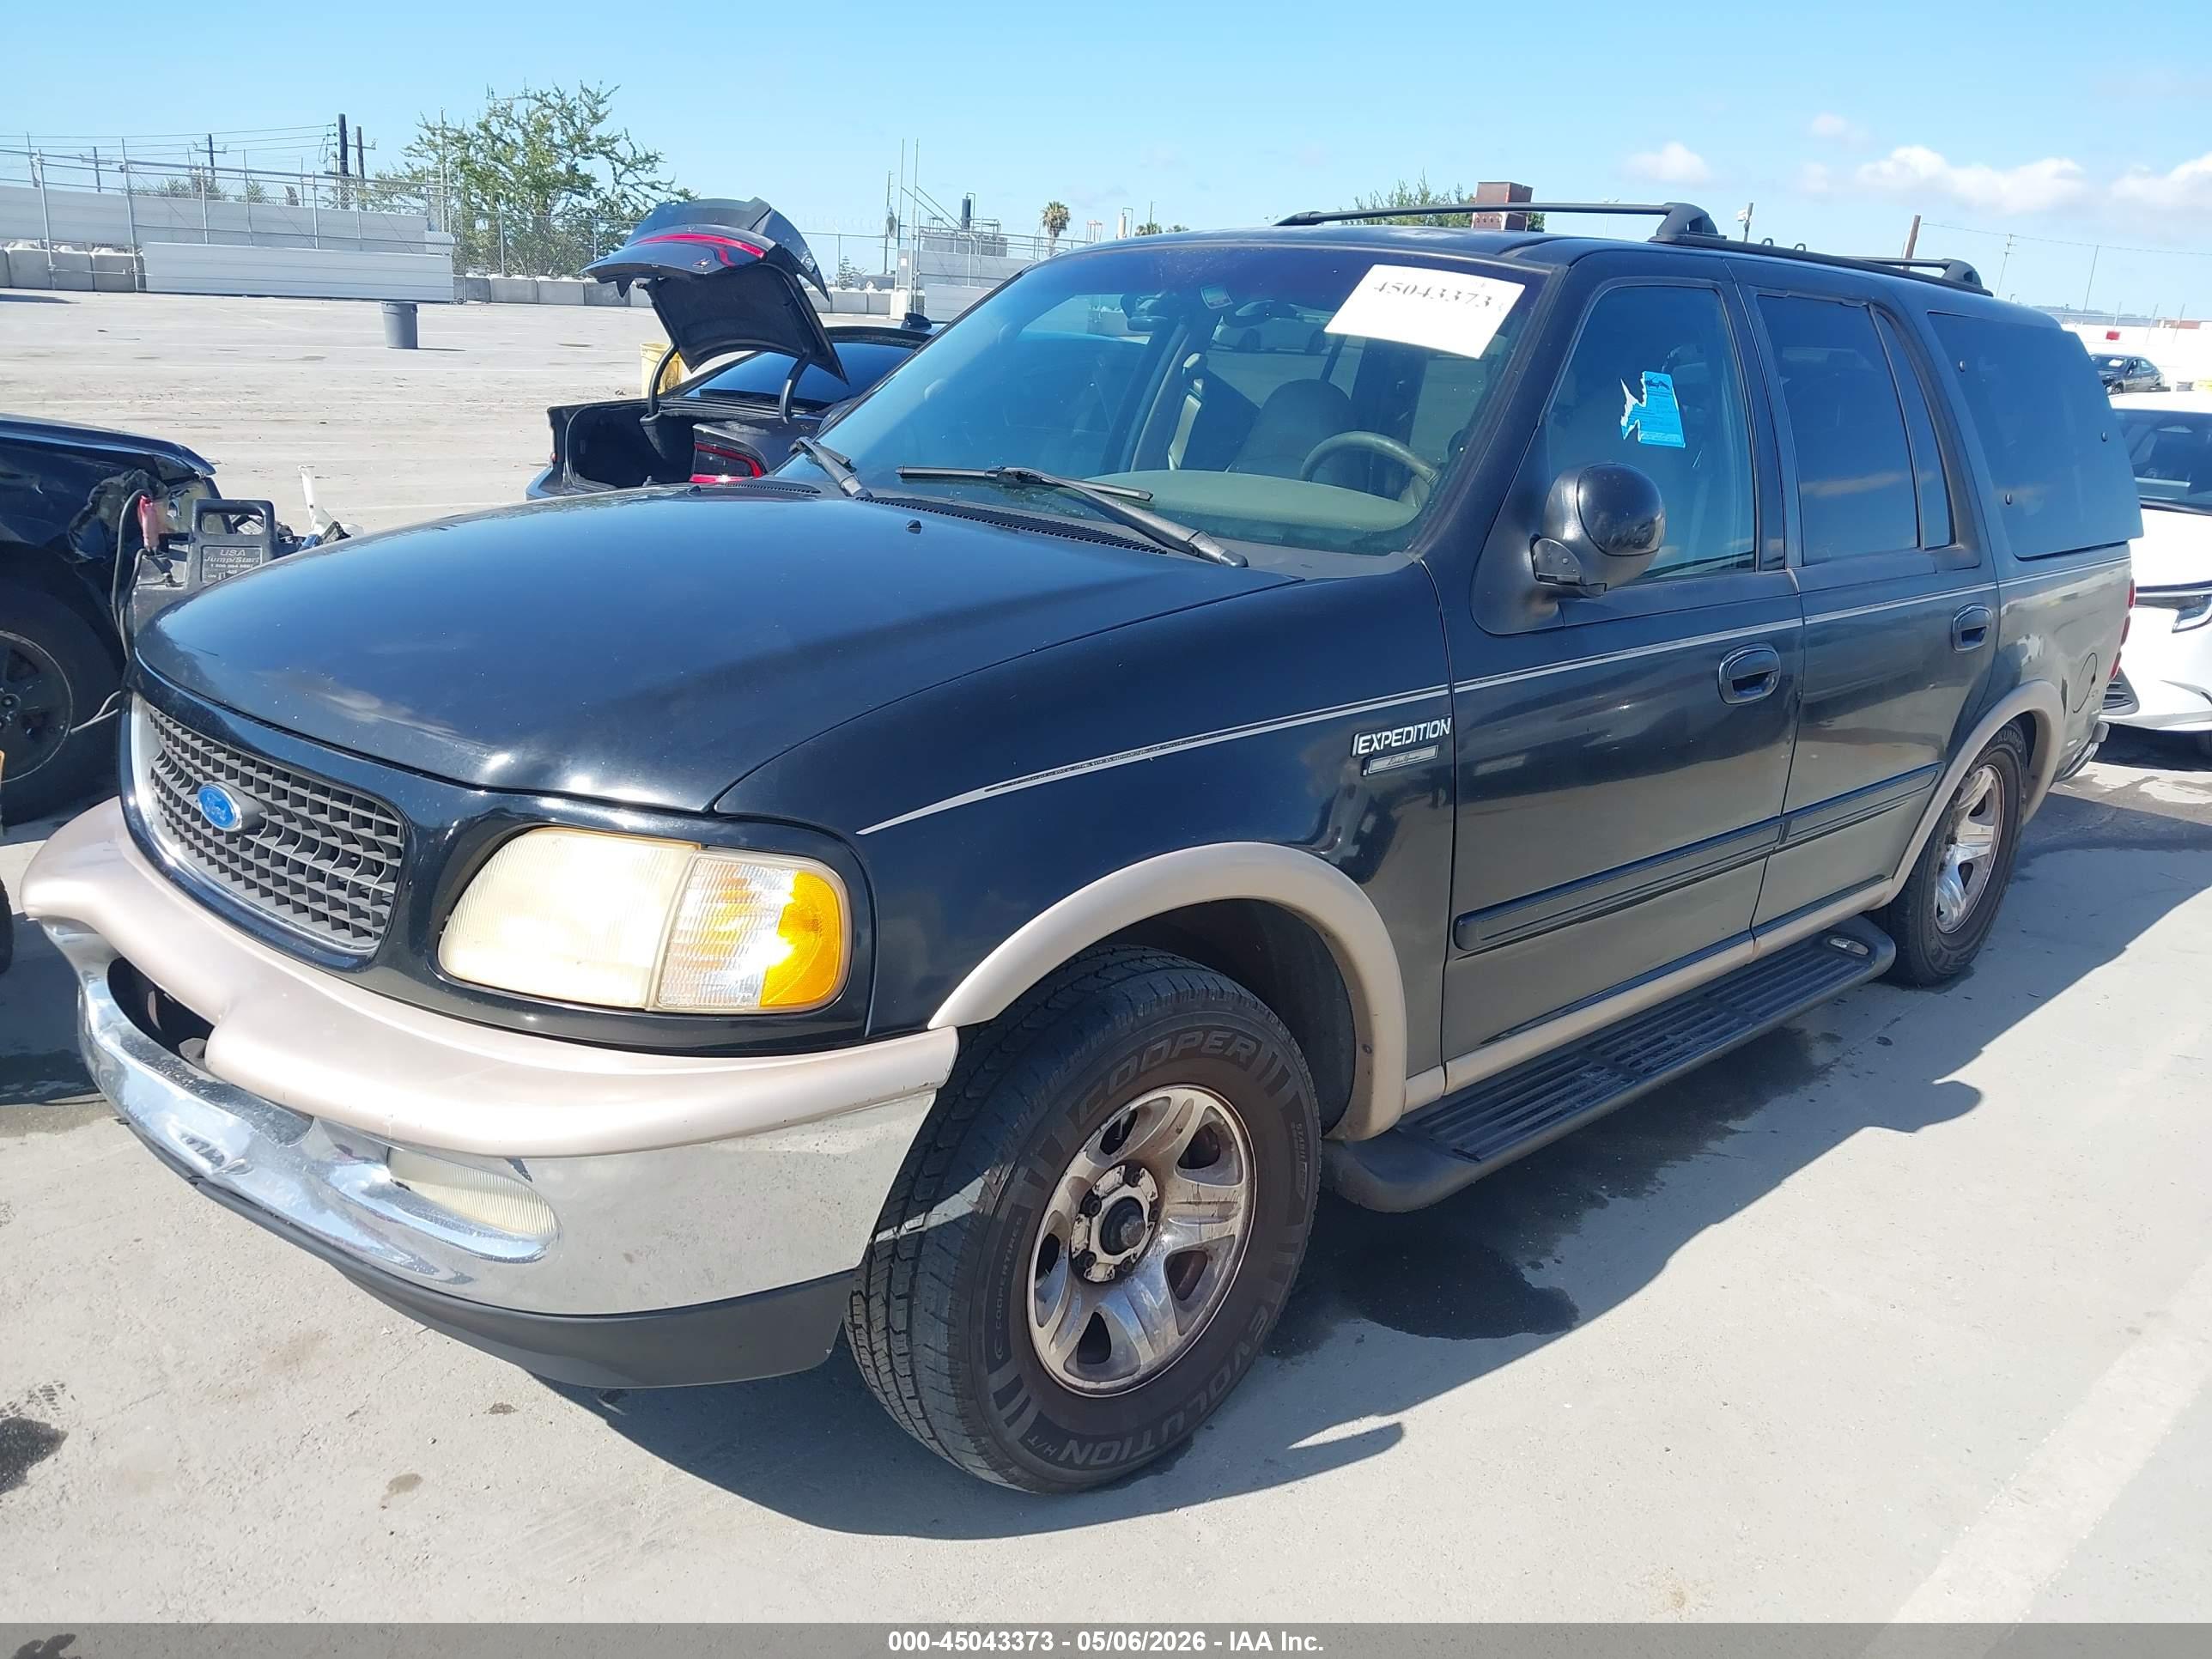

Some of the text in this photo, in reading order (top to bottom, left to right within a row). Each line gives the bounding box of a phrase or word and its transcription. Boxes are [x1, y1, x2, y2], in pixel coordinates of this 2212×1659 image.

[1373, 281, 1492, 307] 45043373
[1356, 717, 1452, 755] EXPEDITION
[1078, 1030, 1257, 1125] COOPER
[1057, 1304, 1270, 1466] EVOLUTION
